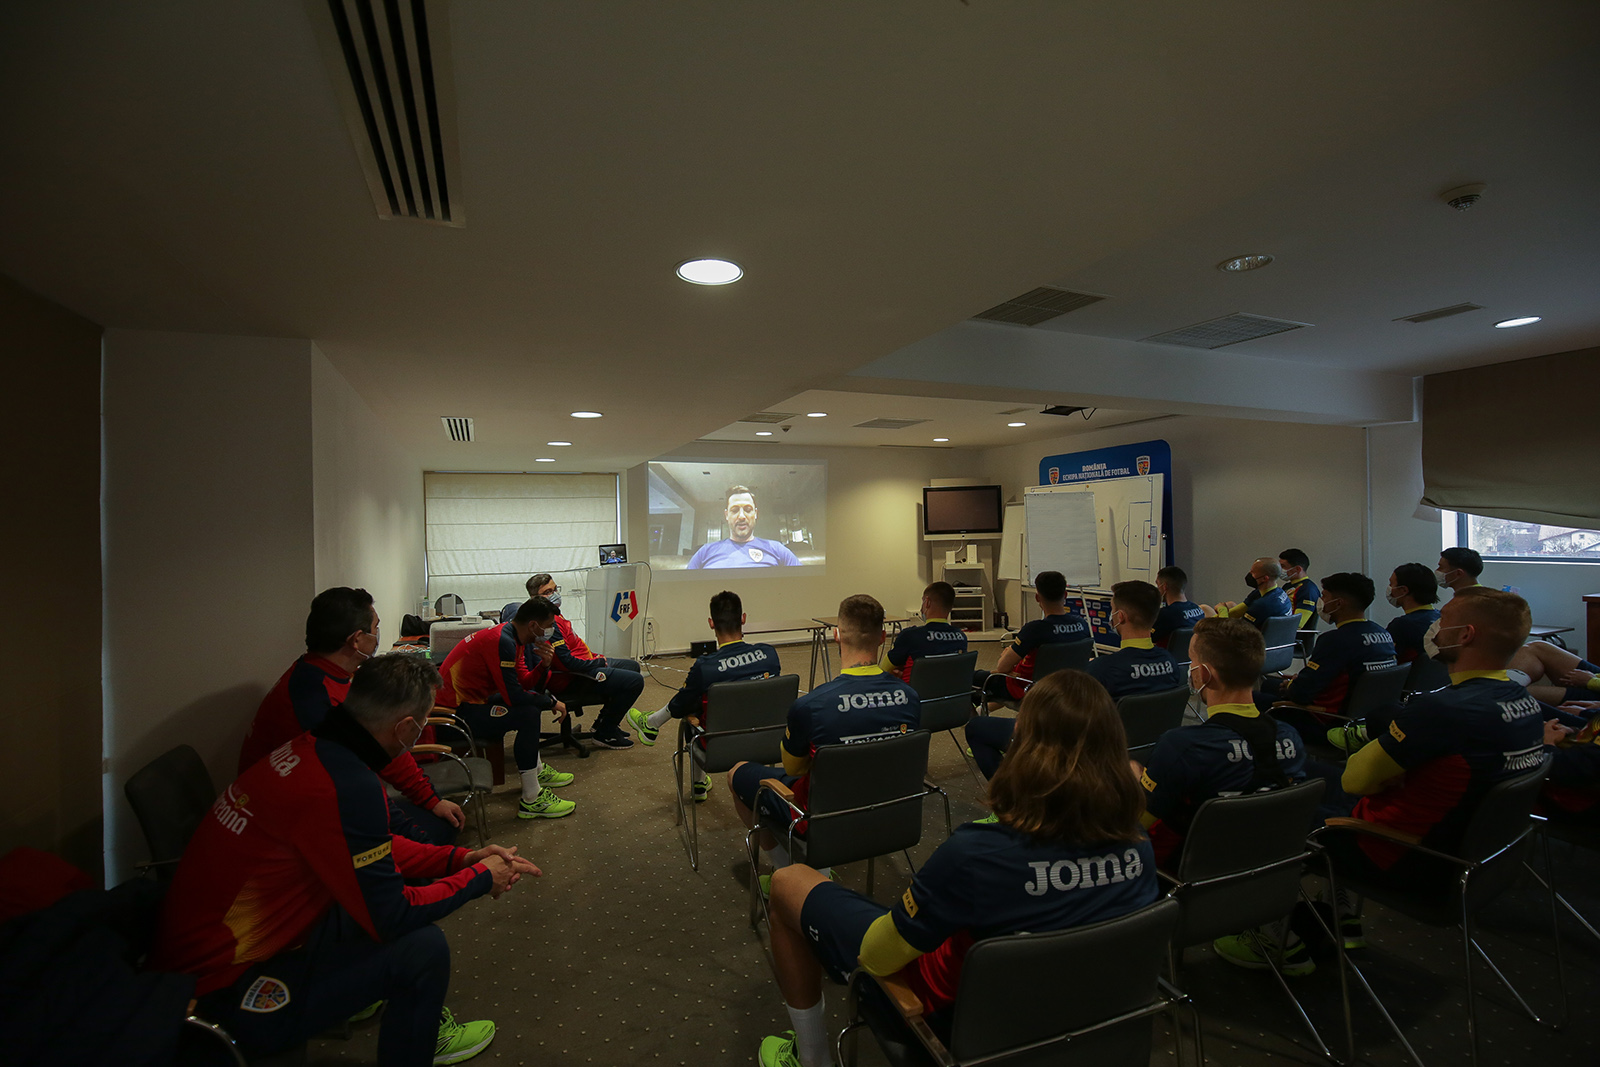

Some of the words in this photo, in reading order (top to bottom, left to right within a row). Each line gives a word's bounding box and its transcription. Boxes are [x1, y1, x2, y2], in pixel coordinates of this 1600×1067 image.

[1062, 473, 1078, 481] ECHIPA
[1105, 469, 1111, 477] DE
[1112, 467, 1130, 476] FOTBAL
[619, 603, 631, 614] FRF
